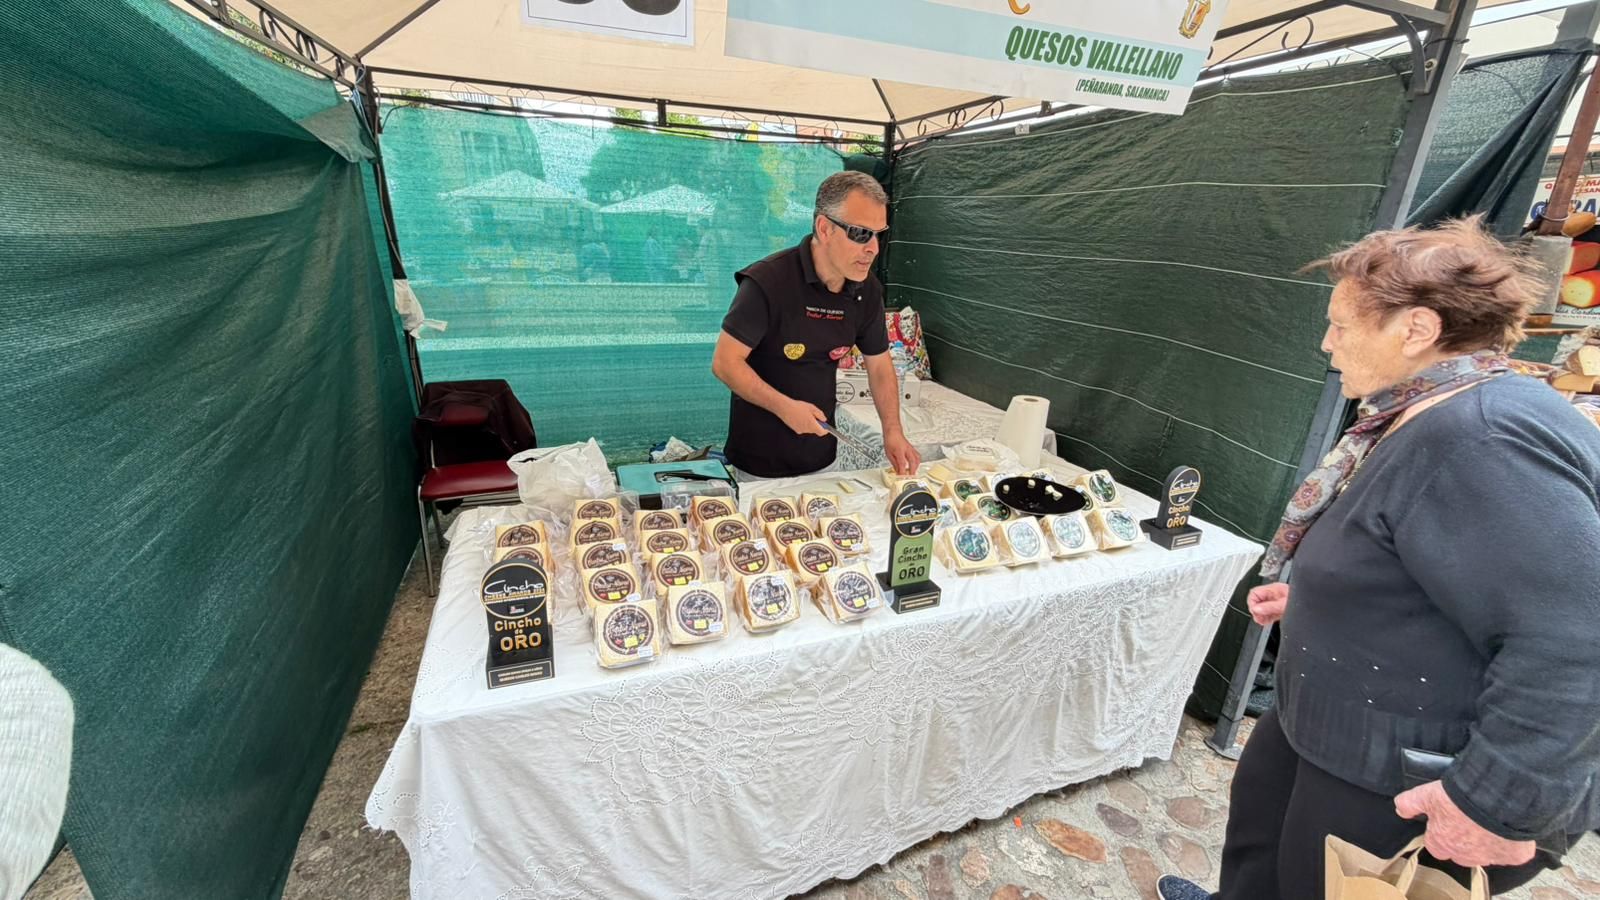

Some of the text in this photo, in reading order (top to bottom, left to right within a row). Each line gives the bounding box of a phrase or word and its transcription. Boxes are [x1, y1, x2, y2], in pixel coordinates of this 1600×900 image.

[1004, 25, 1184, 80] QUESOS VALLELLANO
[1075, 78, 1124, 98] (PEÑARANDA,
[1166, 515, 1186, 528] ORO
[903, 545, 924, 555] Gran
[897, 553, 928, 564] Cincho
[898, 566, 925, 580] ORO
[483, 579, 545, 595] Cincho
[494, 617, 542, 632] Cincho
[499, 632, 542, 652] ORO
